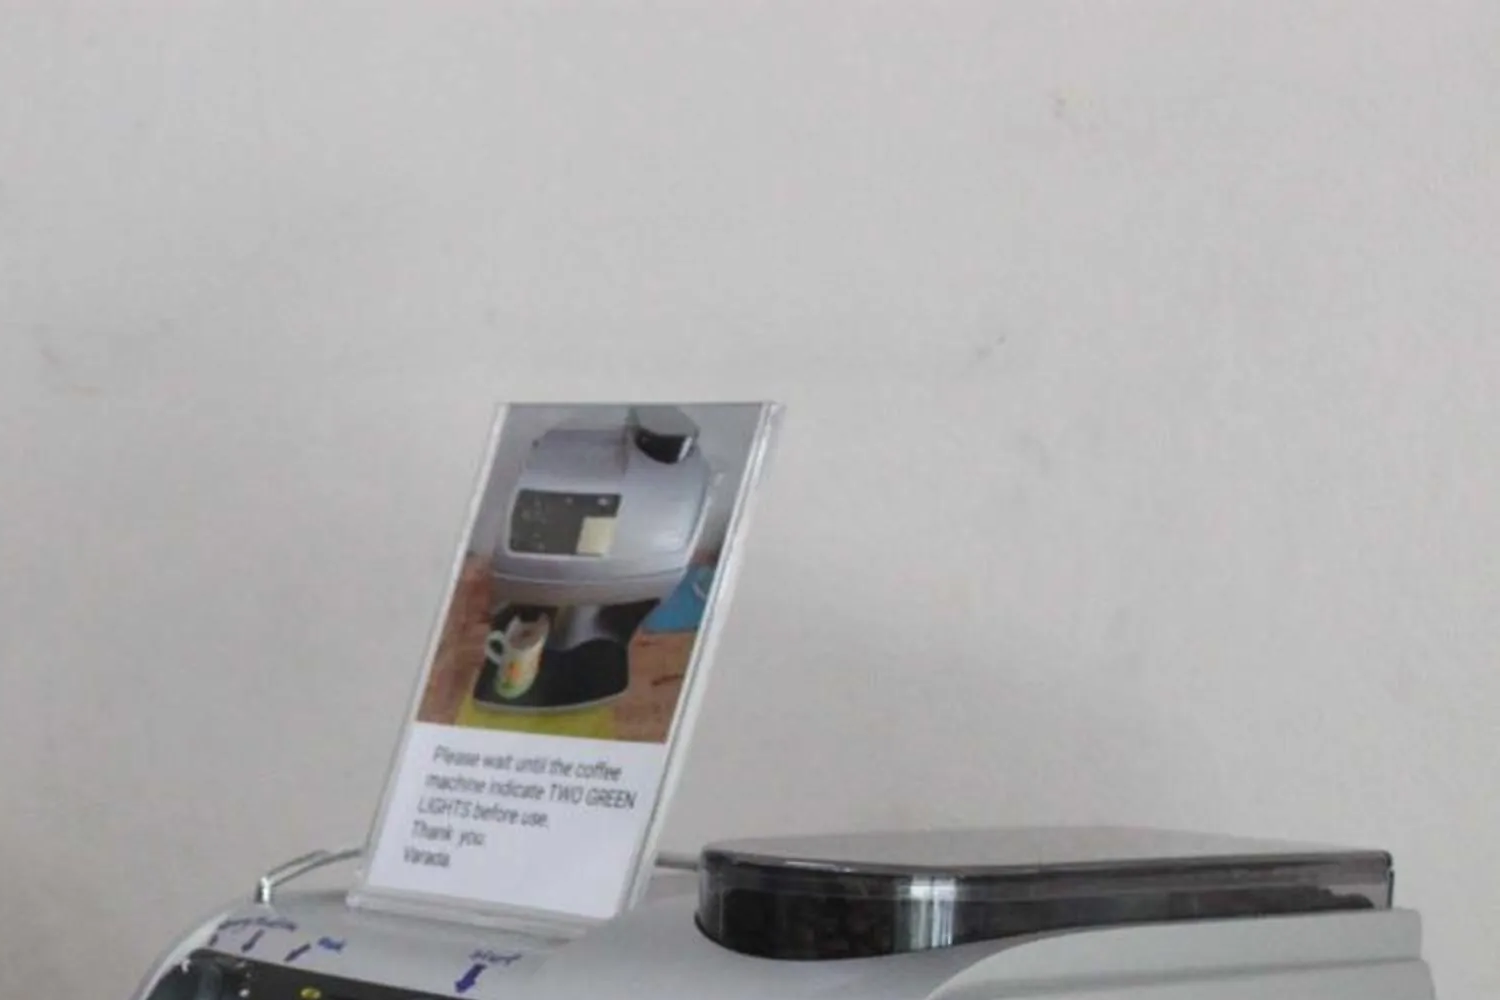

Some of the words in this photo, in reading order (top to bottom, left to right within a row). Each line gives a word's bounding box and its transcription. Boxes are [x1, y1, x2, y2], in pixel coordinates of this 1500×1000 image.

[432, 745, 480, 767] Please
[483, 755, 513, 770] wait
[515, 757, 548, 774] until
[549, 758, 573, 777] the
[574, 761, 622, 782] coffee
[424, 773, 486, 793] machine
[489, 777, 546, 800] indicate
[550, 783, 584, 805] TWO
[585, 788, 638, 810] GREEN
[417, 797, 472, 818] LIGHTS
[472, 801, 519, 824] before
[411, 820, 453, 841] Thank
